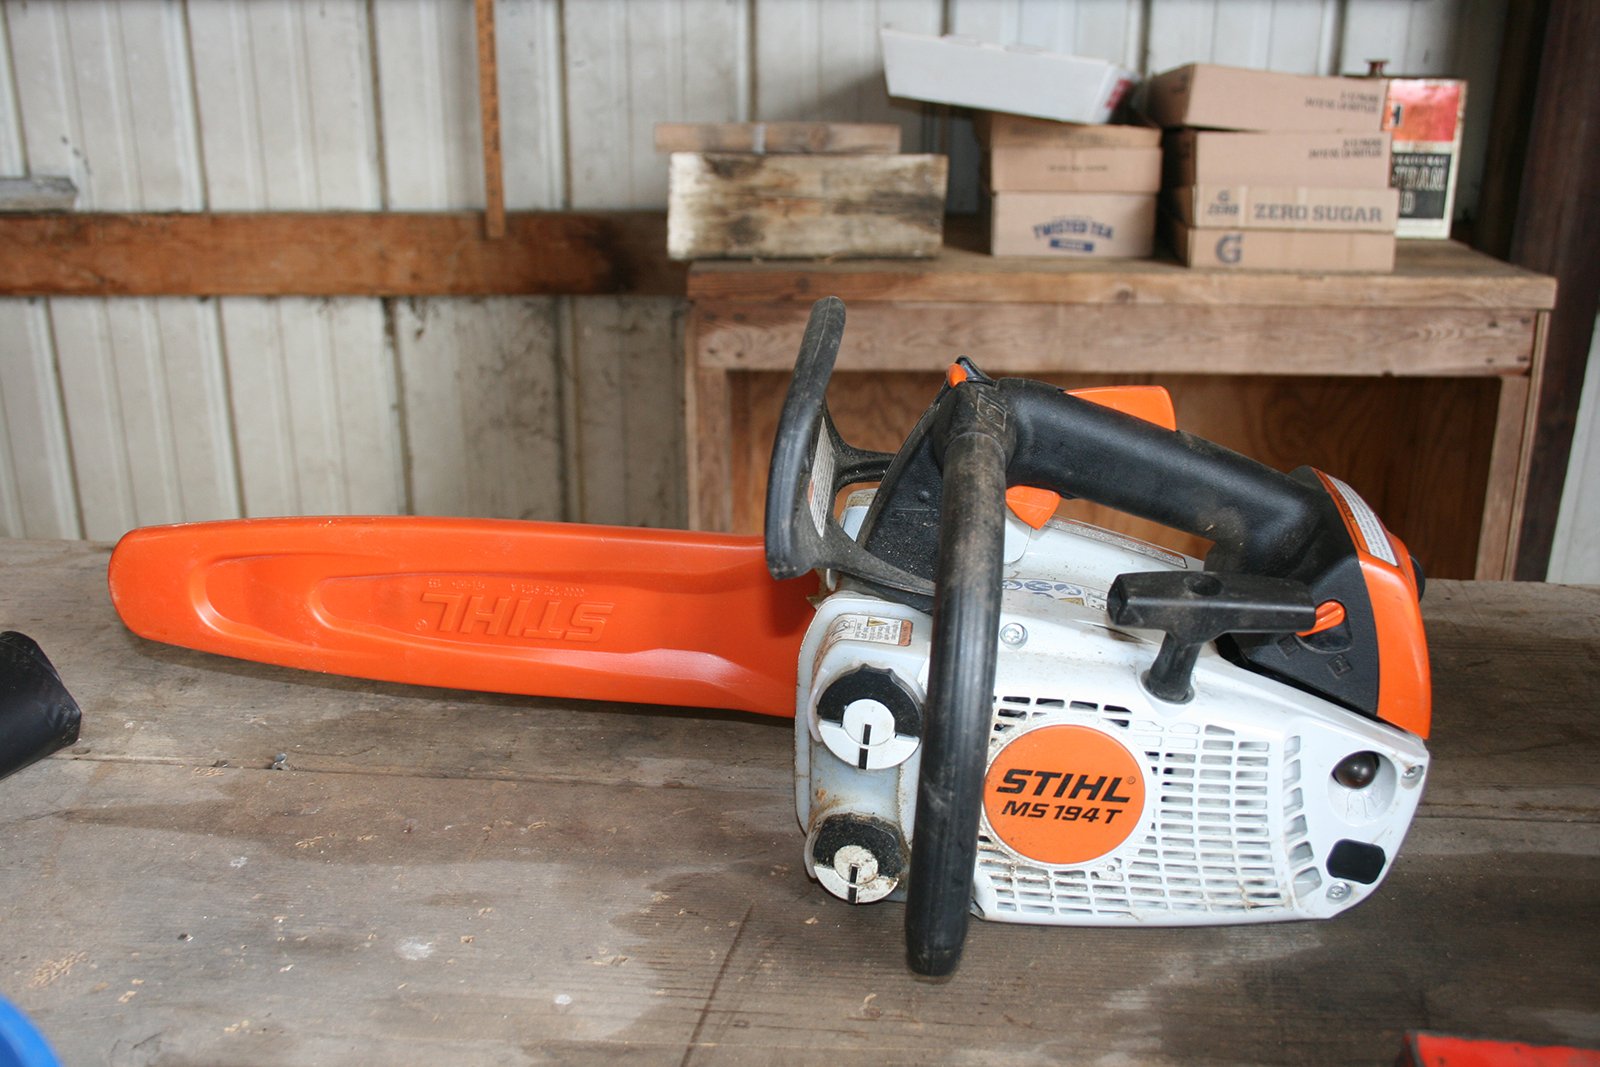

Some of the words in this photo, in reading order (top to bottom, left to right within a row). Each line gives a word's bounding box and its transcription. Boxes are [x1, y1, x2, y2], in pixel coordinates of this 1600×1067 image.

[1254, 203, 1307, 220] ZERO
[1312, 204, 1382, 222] SUGAR
[1033, 218, 1088, 238] TWISTED
[1215, 233, 1243, 264] G
[420, 592, 616, 642] STIHL
[996, 768, 1130, 803] STIHL
[1002, 801, 1050, 818] MS
[1054, 805, 1099, 823] 194
[1104, 809, 1123, 824] T
